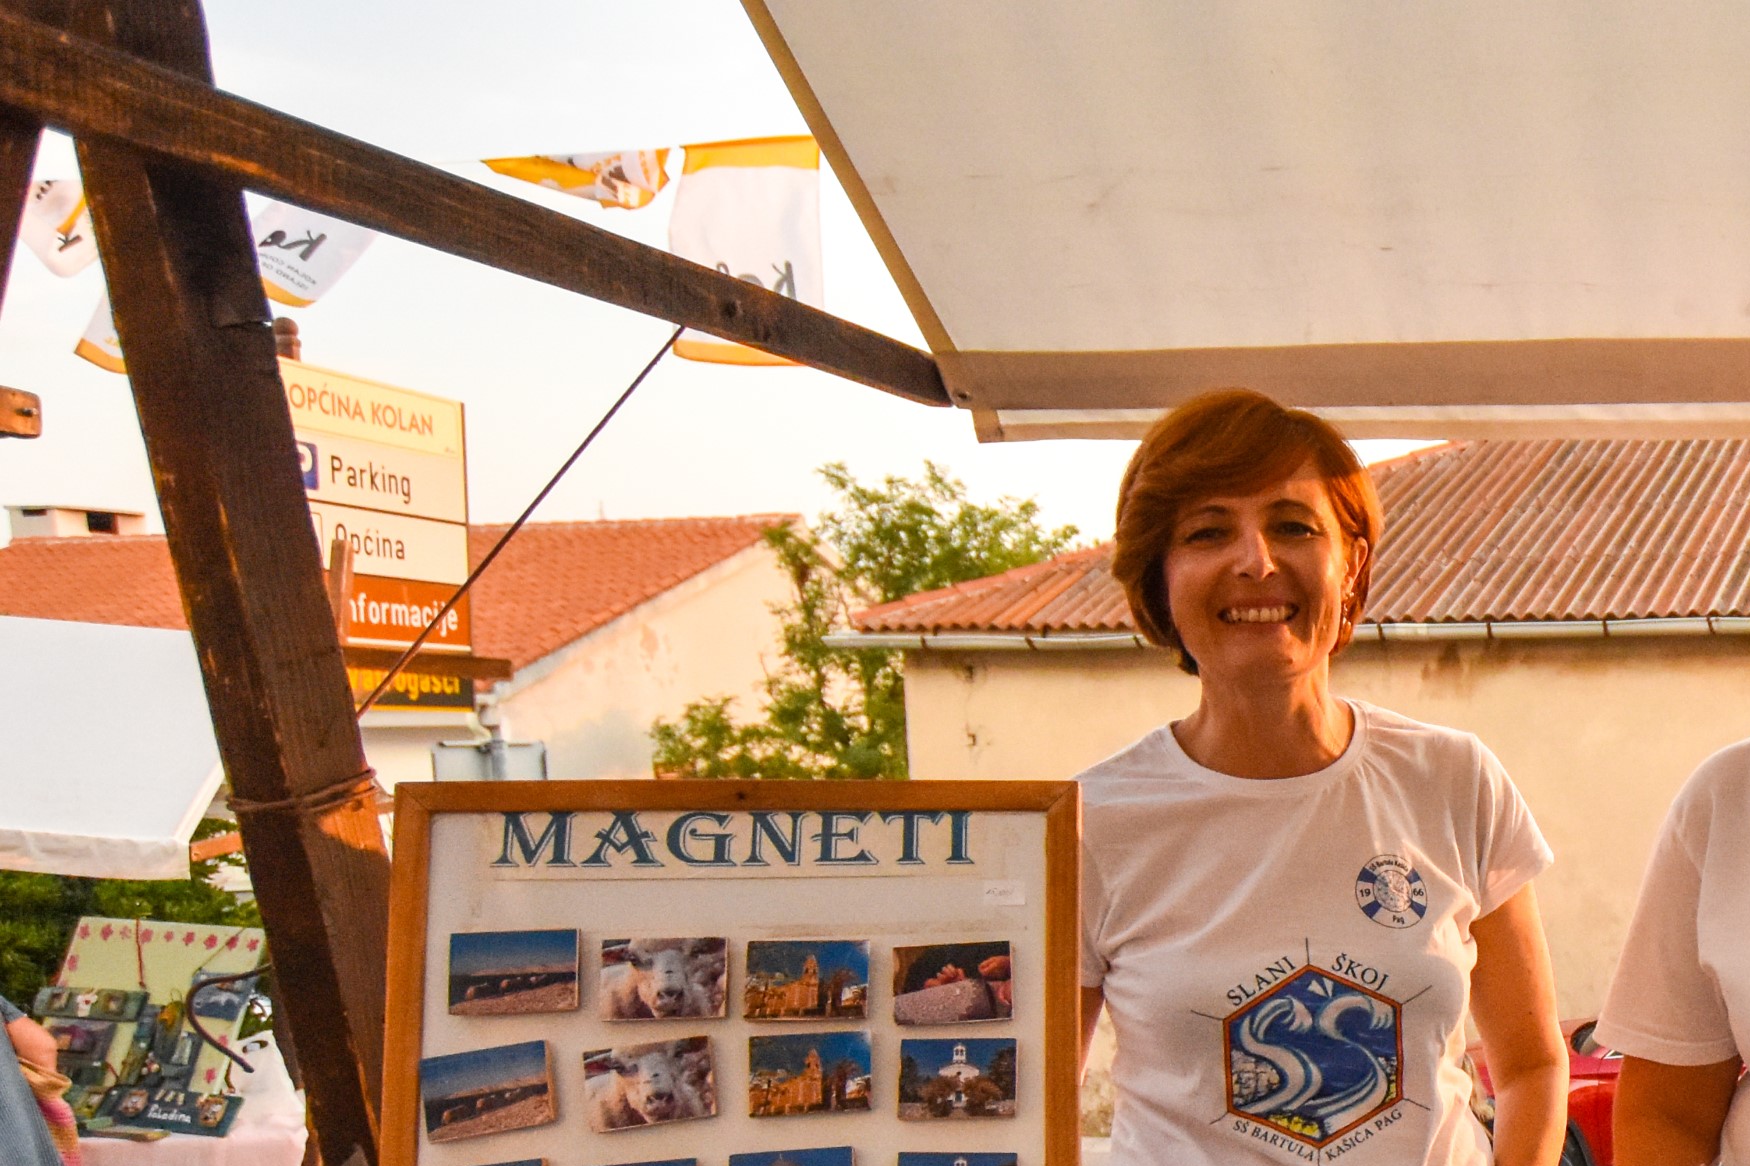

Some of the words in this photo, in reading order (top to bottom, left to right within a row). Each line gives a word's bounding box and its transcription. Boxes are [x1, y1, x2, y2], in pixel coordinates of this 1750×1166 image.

[289, 382, 366, 424] OPĆINA
[371, 401, 434, 437] KOLAN
[330, 455, 412, 504] Parking
[335, 523, 406, 561] Općina
[349, 592, 458, 637] nformacije
[489, 811, 975, 868] MAGNETI
[1359, 888, 1371, 898] 19
[1412, 887, 1424, 897] 66
[1226, 956, 1297, 1007] SLANI
[1330, 952, 1390, 992] ŠKOJ
[1250, 1125, 1315, 1163] BARTULA
[1374, 1107, 1403, 1132] PAG
